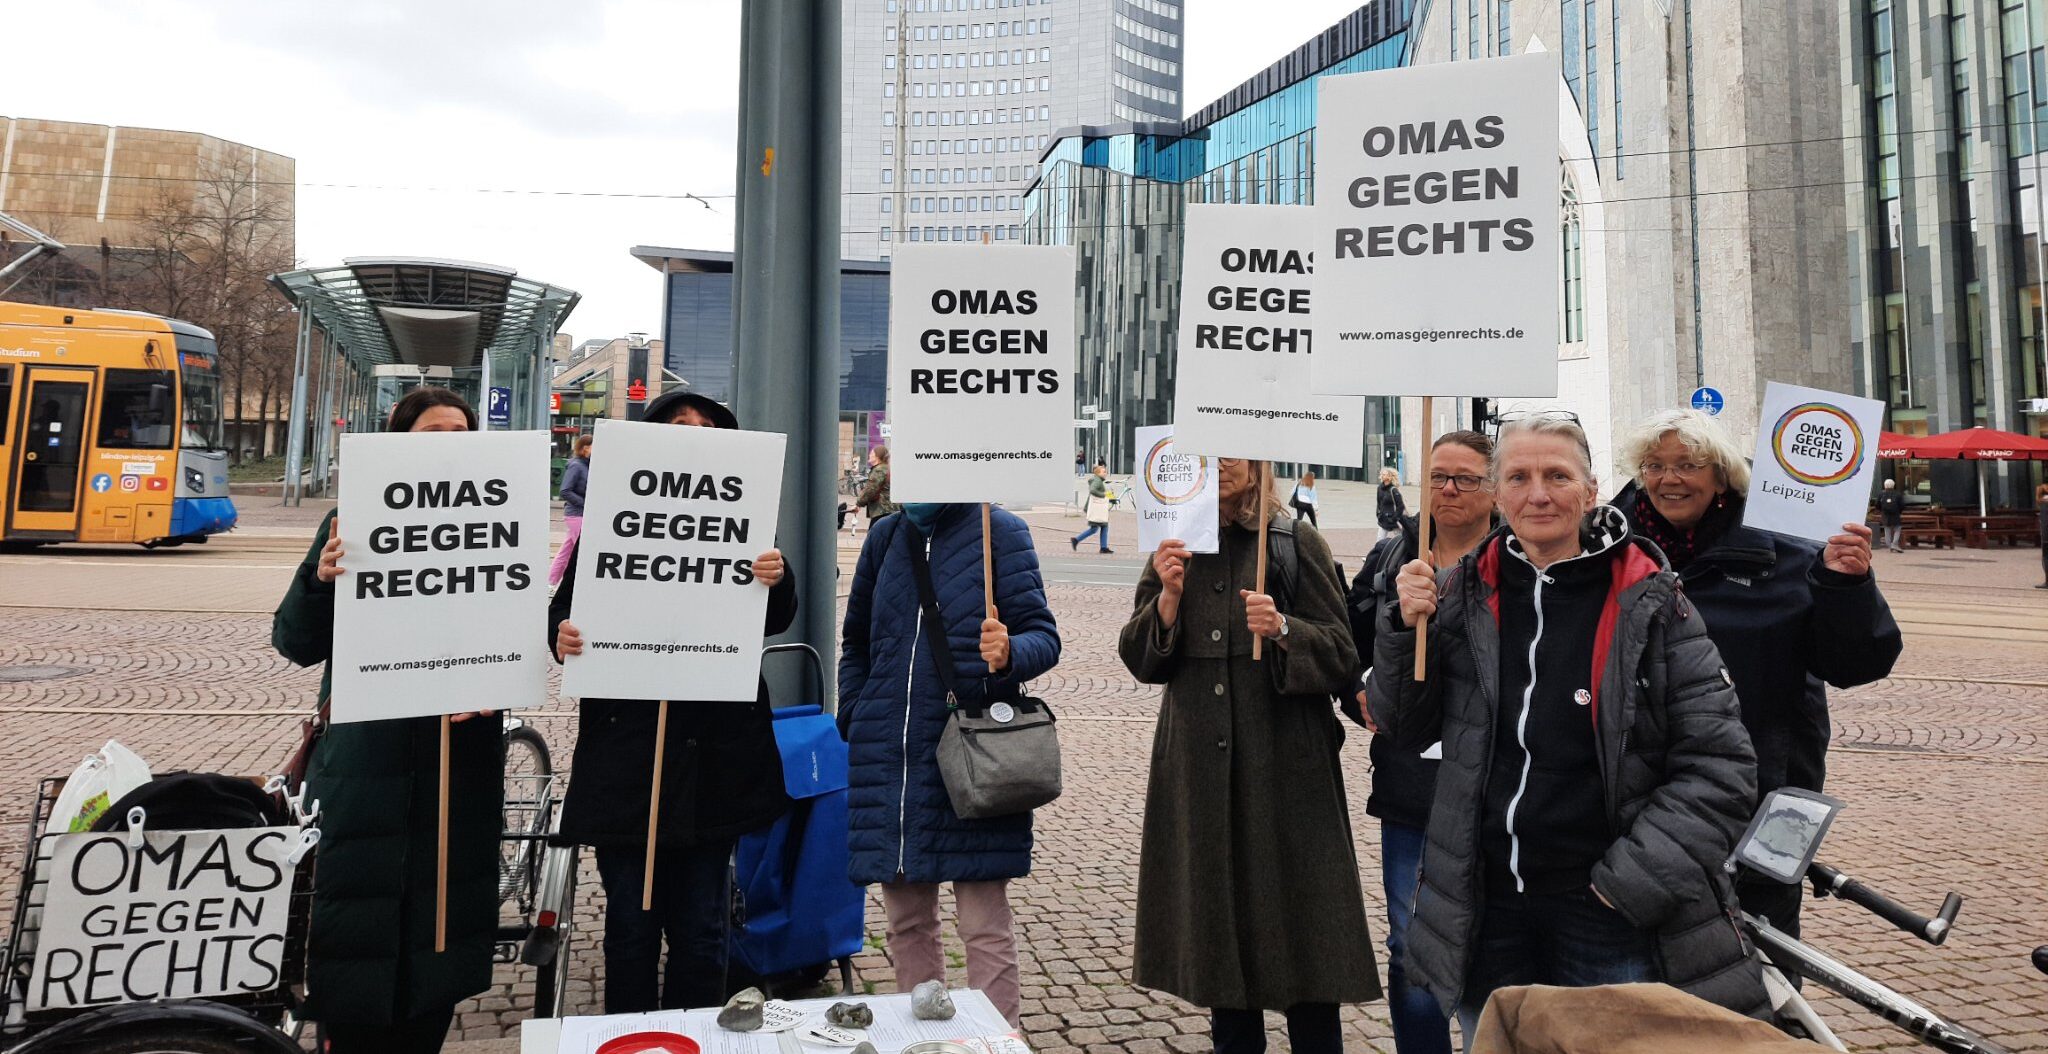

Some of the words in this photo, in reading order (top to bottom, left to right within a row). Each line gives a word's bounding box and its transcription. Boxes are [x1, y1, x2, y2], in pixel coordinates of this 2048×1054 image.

[1363, 115, 1505, 158] OMAS
[1348, 166, 1519, 208] GEGEN
[1335, 218, 1534, 259] RECHTS
[1220, 248, 1313, 275] OMA
[931, 289, 1038, 315] OMAS
[1207, 285, 1311, 314] GEGE
[920, 329, 1048, 355] GEGEN
[1195, 324, 1312, 354] RECHT
[1339, 327, 1524, 343] www.omasgegenrechts.de
[911, 368, 1059, 394] RECHTS
[490, 391, 499, 411] P
[1196, 406, 1339, 422] www.omasgegenrechts.de
[1795, 433, 1842, 451] GEGEN
[1800, 422, 1842, 439] OMAS
[915, 451, 1053, 462] www.omasgegenrechts.de
[1160, 454, 1190, 463] OMAS
[1791, 444, 1843, 463] RECHTS
[1976, 449, 2014, 457] VAPIANO
[1157, 472, 1193, 483] RECHTS
[1158, 463, 1192, 473] GEGEN
[384, 479, 509, 510] OMAS
[630, 470, 743, 502] OMAS
[1761, 480, 1816, 504] Leipzig
[612, 511, 750, 544] GEGEN
[1143, 509, 1178, 522] Leipzig
[369, 521, 519, 554] GEGEN
[355, 563, 531, 600] RECHTS
[595, 552, 755, 586] RECHTS
[591, 640, 740, 654] www.omasgegenrechts.de
[359, 652, 522, 673] www.omasgegenrechts.de
[71, 831, 287, 896] OMAS
[81, 896, 265, 938] GEGEN
[40, 933, 285, 1008] RECHTS
[763, 1011, 793, 1022] GEGE
[764, 1002, 804, 1018] RECHTS
[820, 1025, 856, 1042] OMAS
